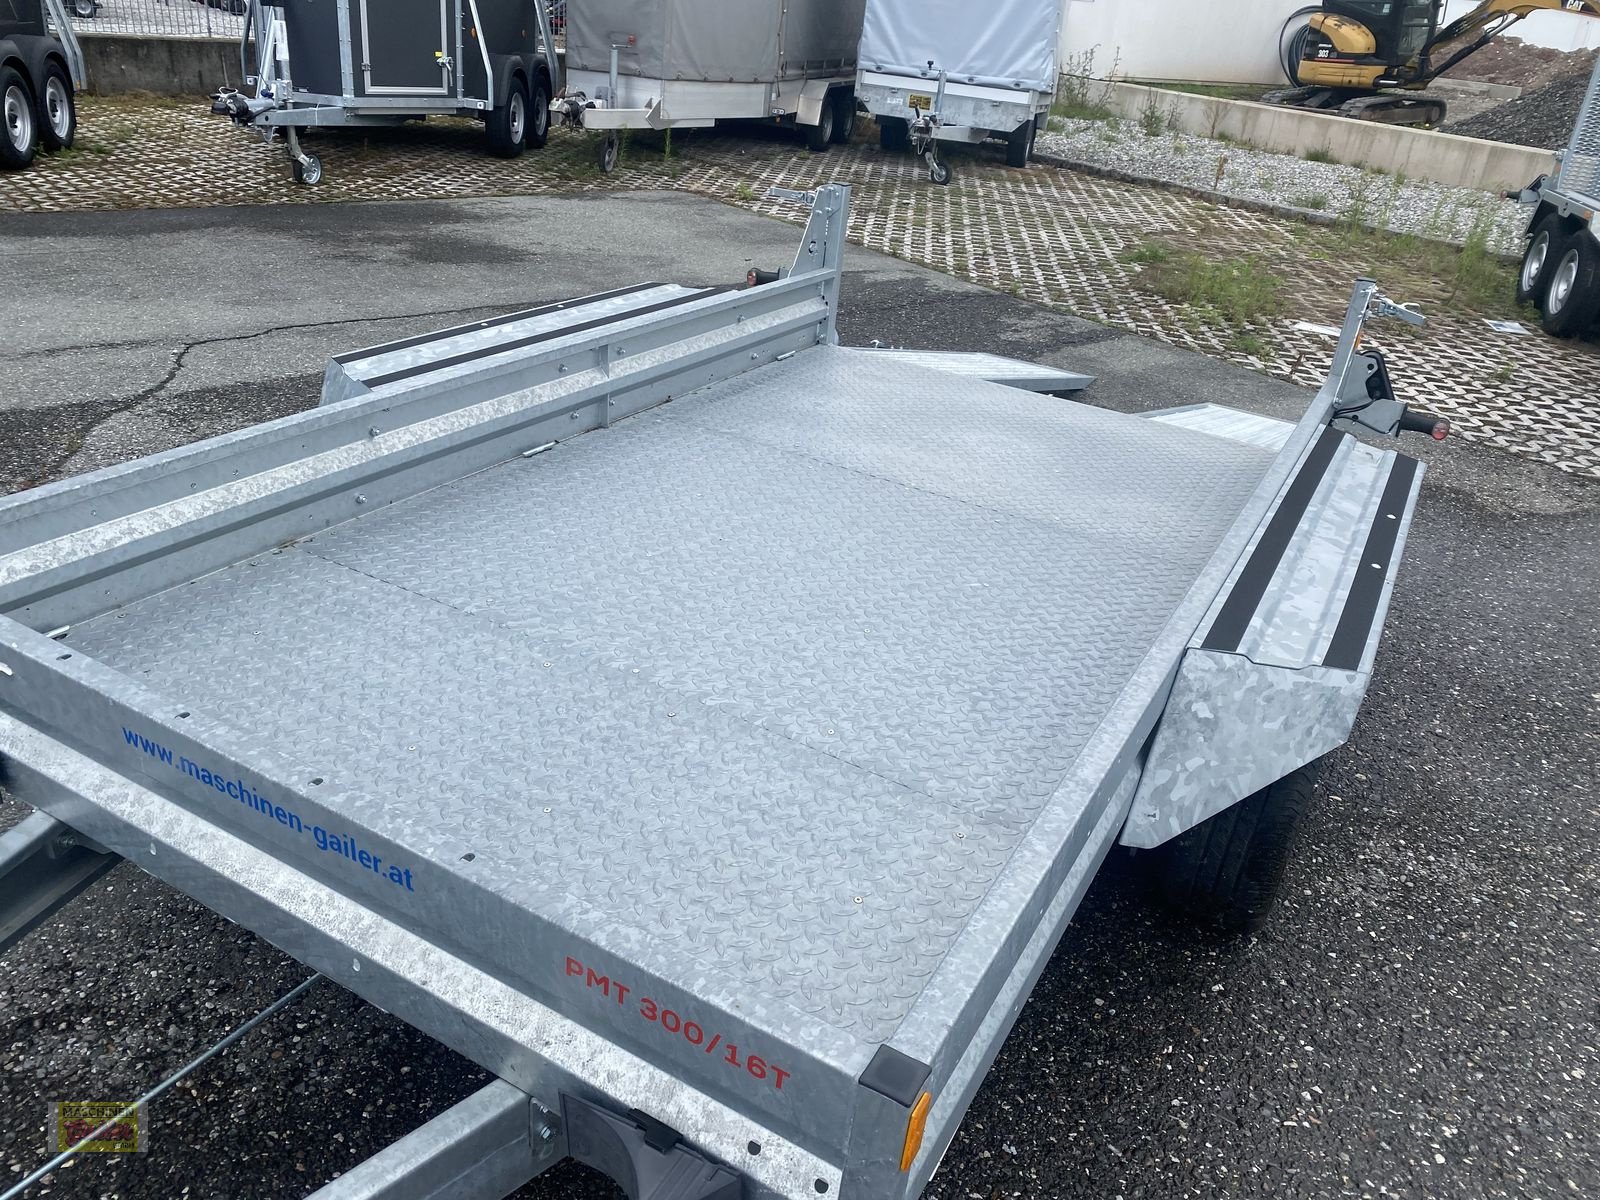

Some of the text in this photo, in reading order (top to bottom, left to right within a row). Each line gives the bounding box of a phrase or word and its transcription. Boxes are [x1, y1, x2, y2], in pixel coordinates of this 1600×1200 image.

[1566, 0, 1585, 11] CAT
[122, 727, 414, 892] www.maschinen-gailer.at
[566, 956, 790, 1089] PMT 300/16T
